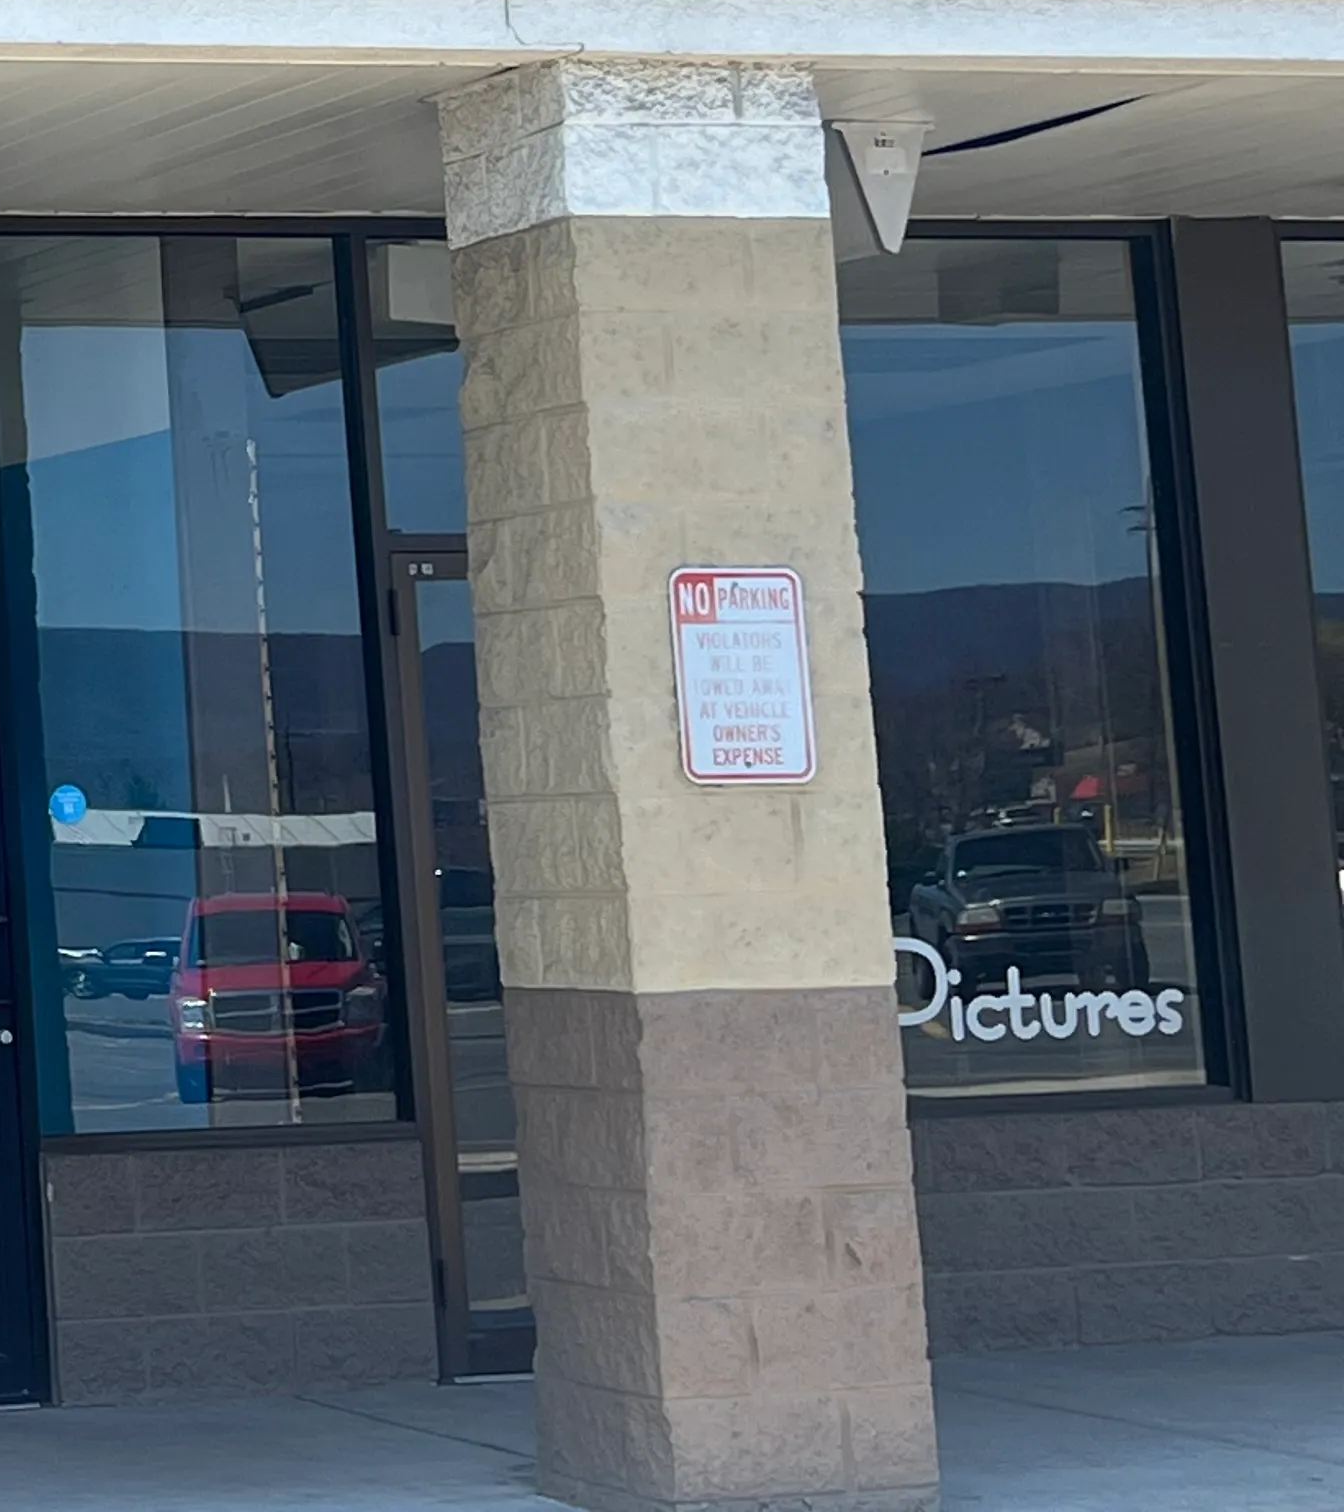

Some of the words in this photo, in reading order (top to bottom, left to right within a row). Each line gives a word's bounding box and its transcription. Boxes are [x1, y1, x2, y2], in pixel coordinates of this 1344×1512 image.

[678, 582, 710, 616] NO
[718, 587, 789, 611] PARKING
[696, 632, 783, 650] VIOLATORS
[709, 656, 745, 673] WILL
[752, 655, 774, 672] BE
[699, 702, 717, 719] AT
[724, 701, 792, 719] VEHICLE
[713, 725, 781, 742] OWNER'S
[713, 748, 783, 767] EXPENSE
